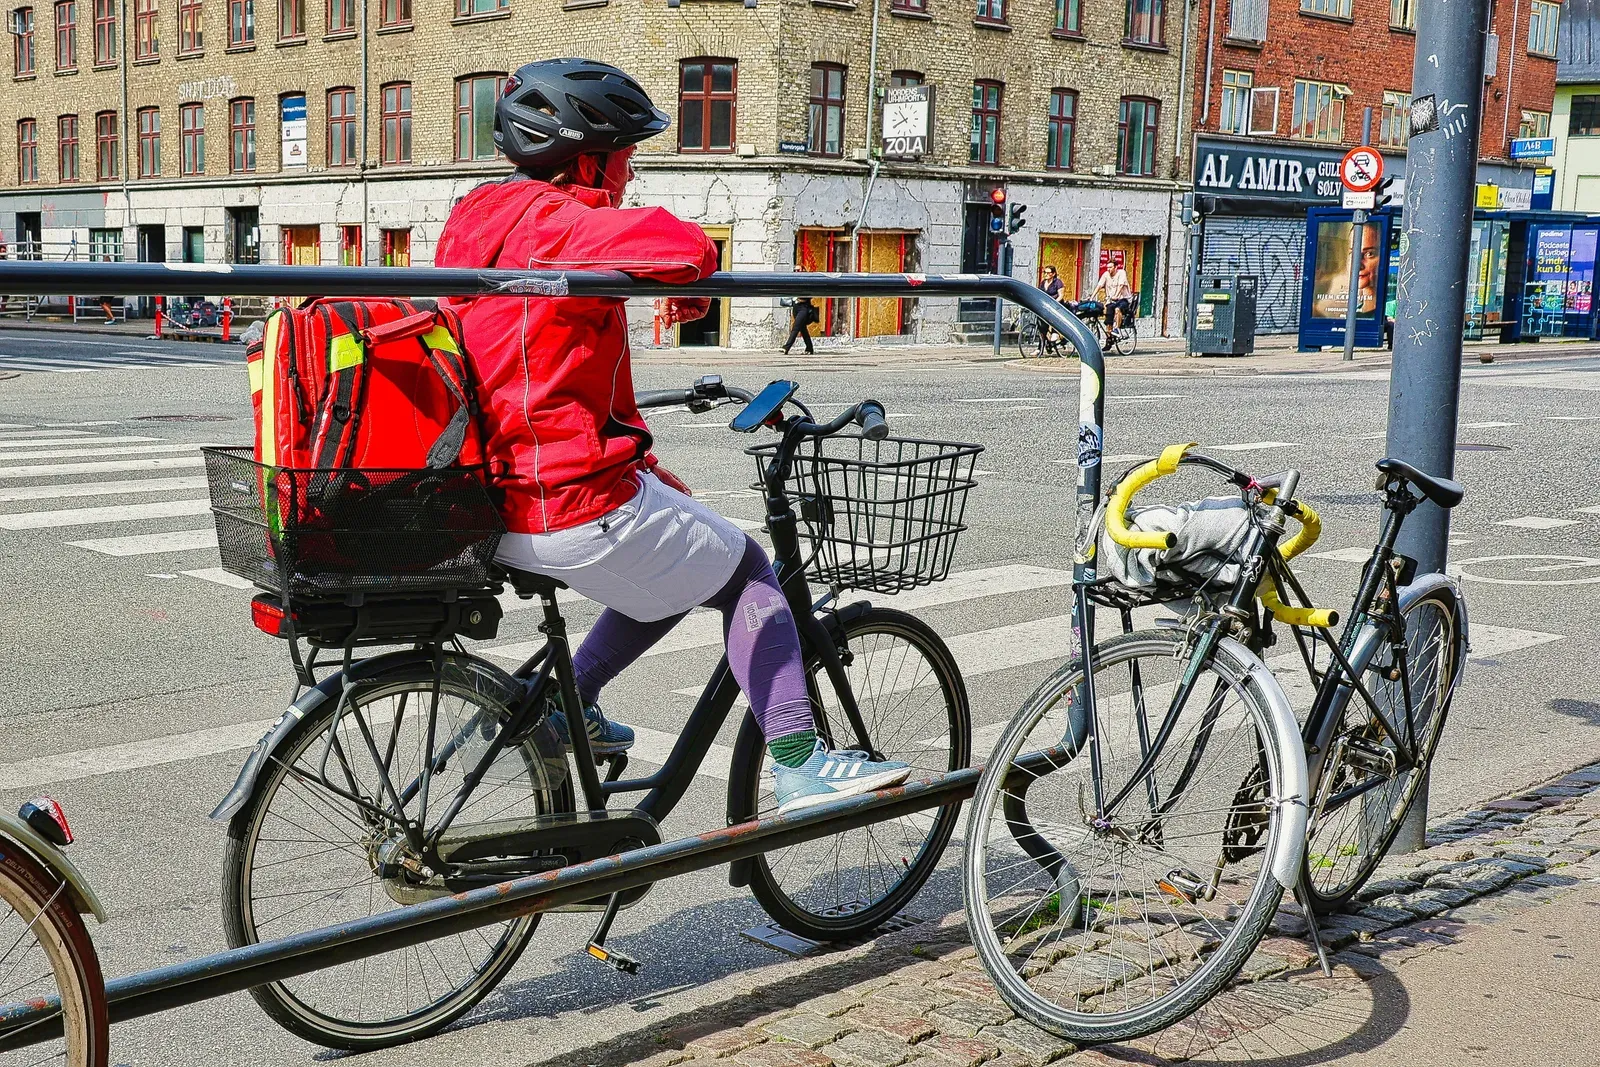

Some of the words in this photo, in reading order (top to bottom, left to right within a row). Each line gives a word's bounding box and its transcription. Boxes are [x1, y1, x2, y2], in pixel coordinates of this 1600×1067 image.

[562, 129, 581, 139] ABUS
[885, 137, 924, 154] ZOLA
[1198, 153, 1234, 188] AL
[1237, 156, 1303, 193] AMIR
[1317, 179, 1342, 197] SØLV
[1539, 241, 1569, 249] Podcasts
[1537, 265, 1554, 273] kun
[1554, 264, 1562, 273] 9
[1538, 256, 1544, 265] 3
[1545, 257, 1565, 265] mdr.
[746, 603, 759, 629] REGION
[5, 858, 26, 874] DELTA
[24, 870, 48, 895] CRUISER
